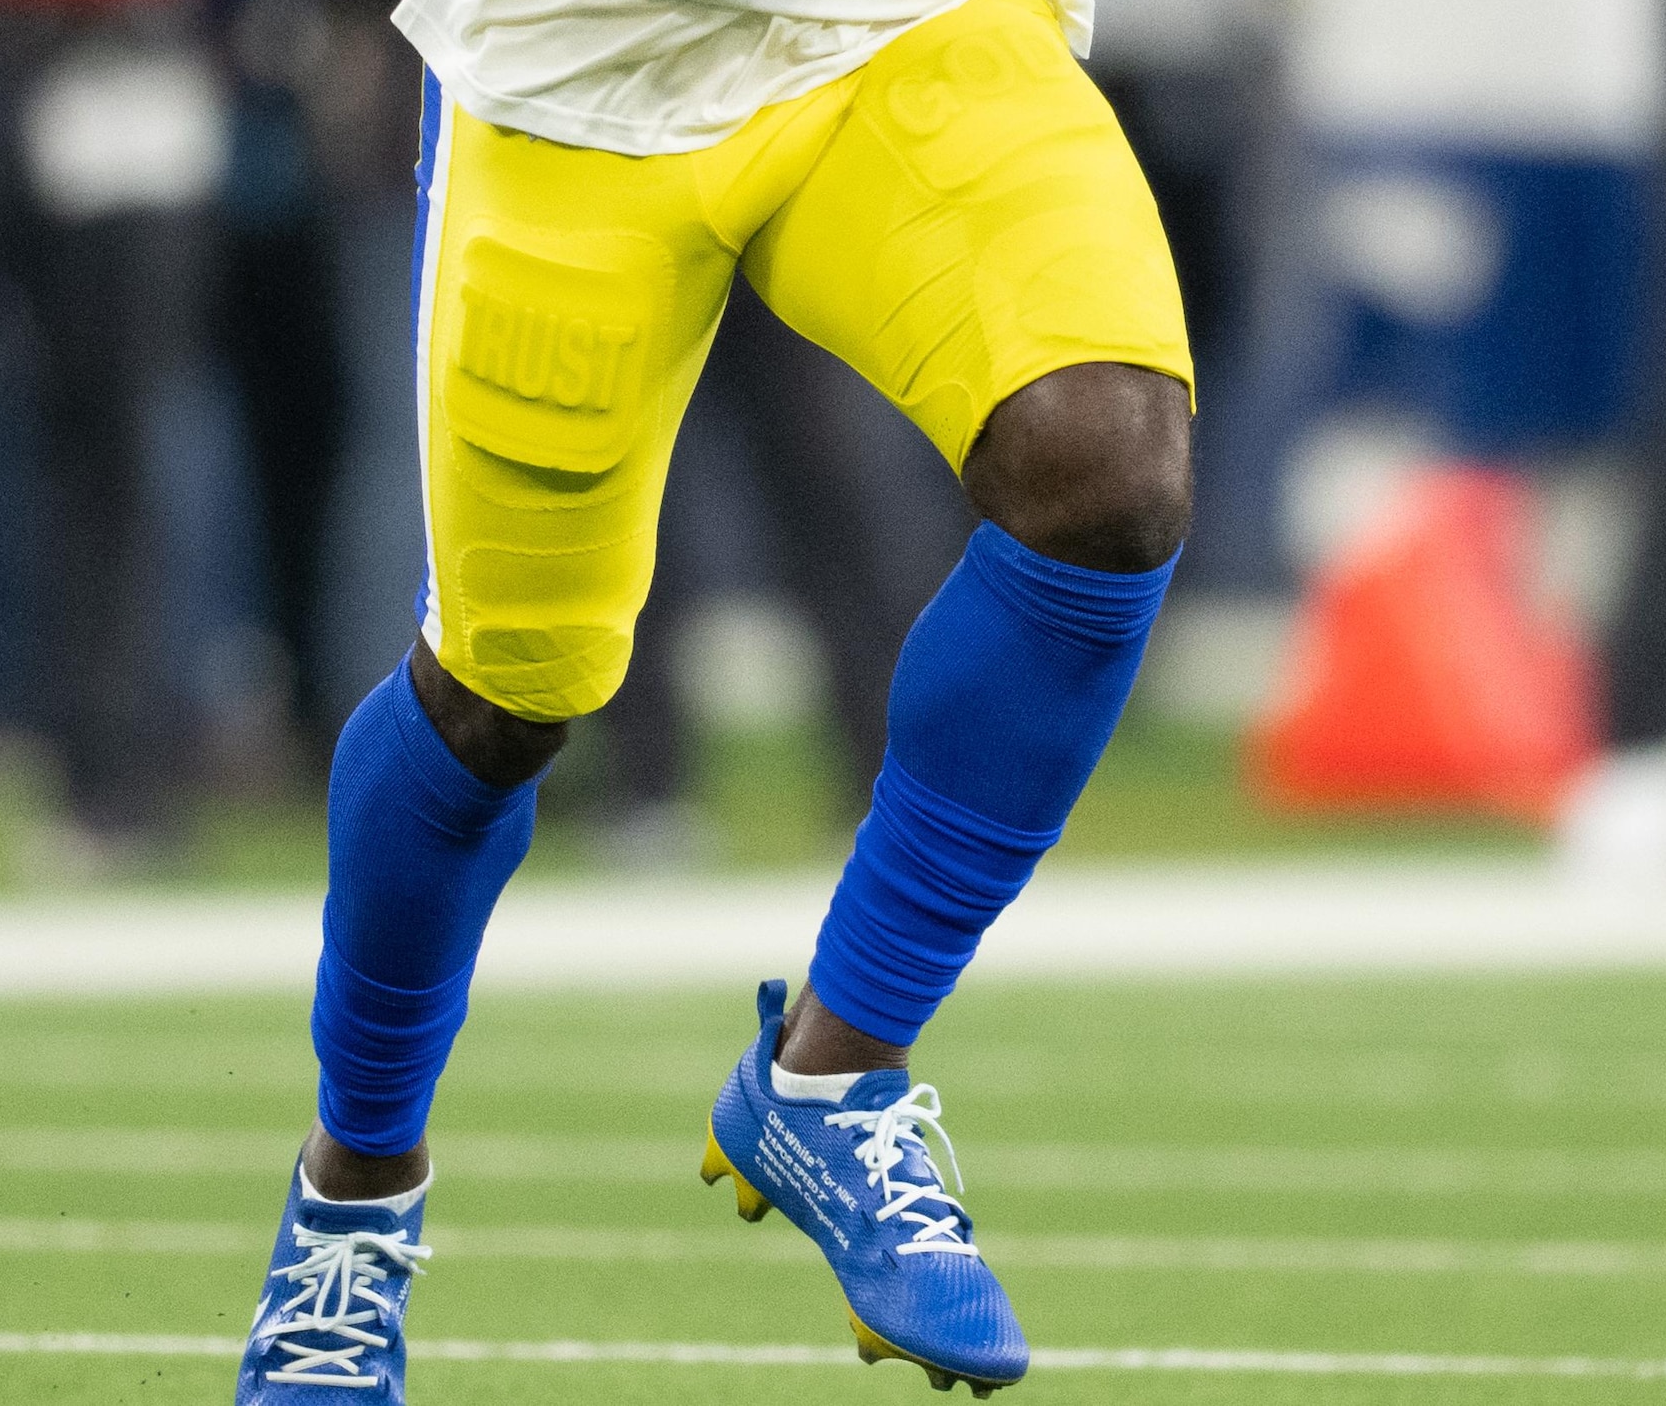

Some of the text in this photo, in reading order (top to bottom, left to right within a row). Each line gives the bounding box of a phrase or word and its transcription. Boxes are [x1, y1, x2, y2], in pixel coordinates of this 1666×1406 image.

[459, 284, 636, 410] TRUST
[793, 1162, 819, 1194] SPEED
[820, 1169, 837, 1189] for
[834, 1185, 858, 1212] NIKE
[804, 1191, 835, 1231] Oregon
[834, 1226, 850, 1251] USA
